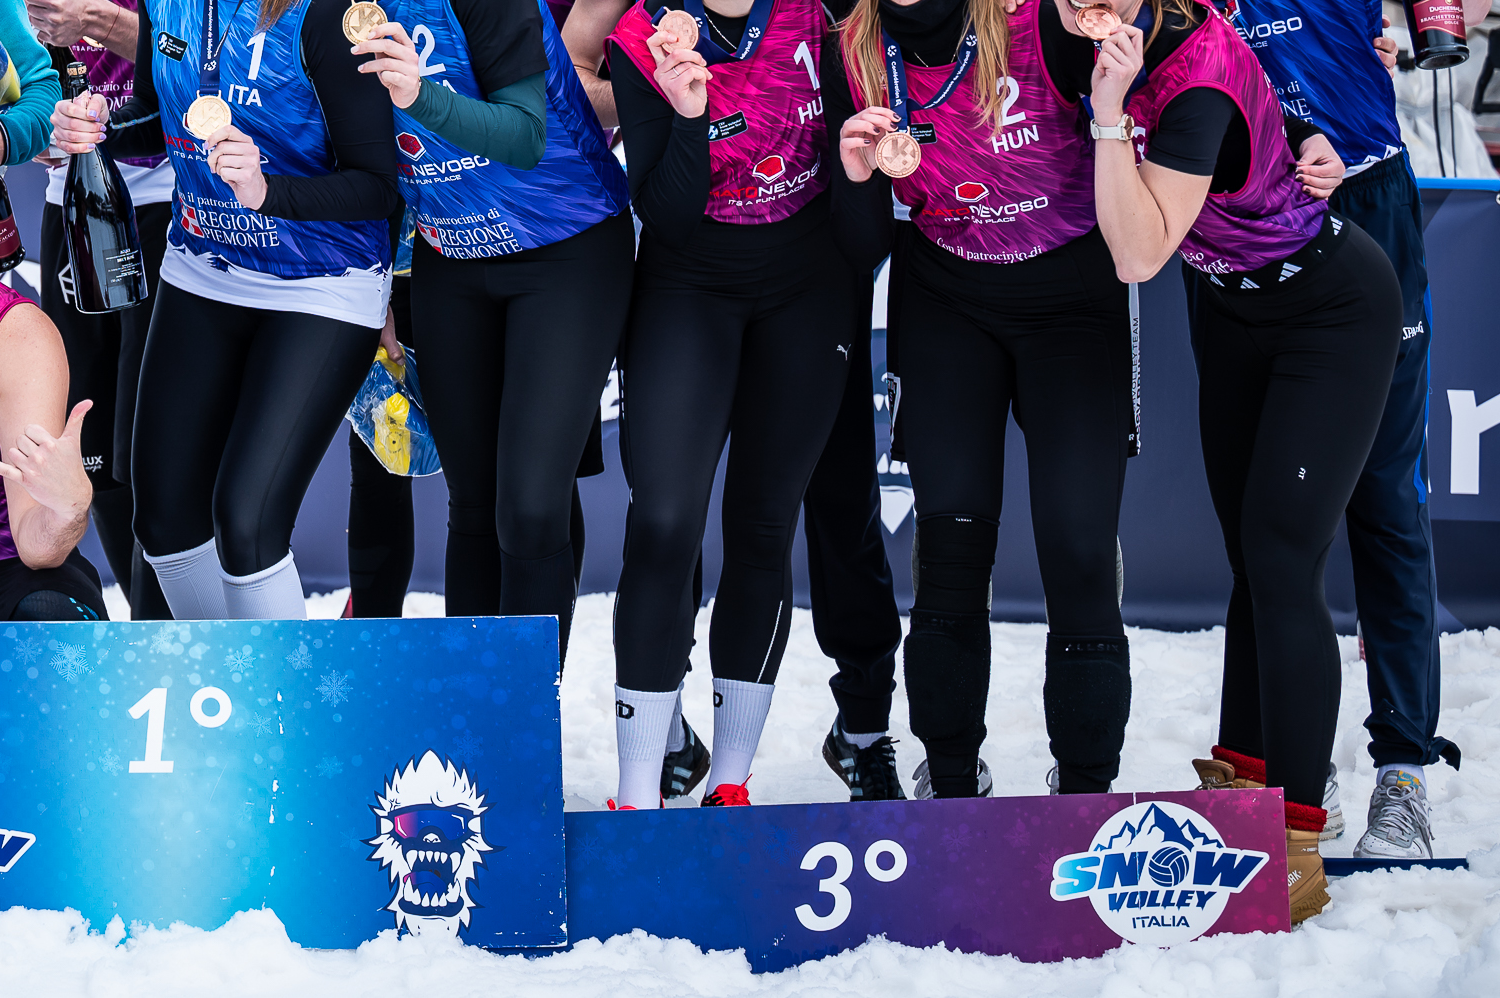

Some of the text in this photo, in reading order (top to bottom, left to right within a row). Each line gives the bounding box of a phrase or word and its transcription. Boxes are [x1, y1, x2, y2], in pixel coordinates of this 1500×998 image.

[246, 33, 266, 80] 1
[413, 24, 447, 76] 2
[793, 41, 820, 90] 1
[228, 84, 262, 107] ITA
[1288, 81, 1301, 94] di
[996, 77, 1026, 127] 2
[798, 105, 822, 125] HU
[992, 124, 1039, 154] HUN
[434, 174, 462, 183] PLACE
[188, 192, 195, 204] il
[755, 193, 776, 205] FUN
[198, 209, 278, 230] REGIONE
[423, 207, 502, 228] il patrocinio di
[986, 215, 1016, 224] PLACE
[203, 227, 280, 248] PIEMONTE
[439, 222, 515, 247] REGIONE
[443, 239, 523, 260] PIEMONTE
[936, 237, 955, 252] Con
[957, 245, 965, 258] il
[1055, 849, 1264, 896] SNOW
[1105, 888, 1216, 913] VOLLEY
[1130, 912, 1192, 931] ITALIA
